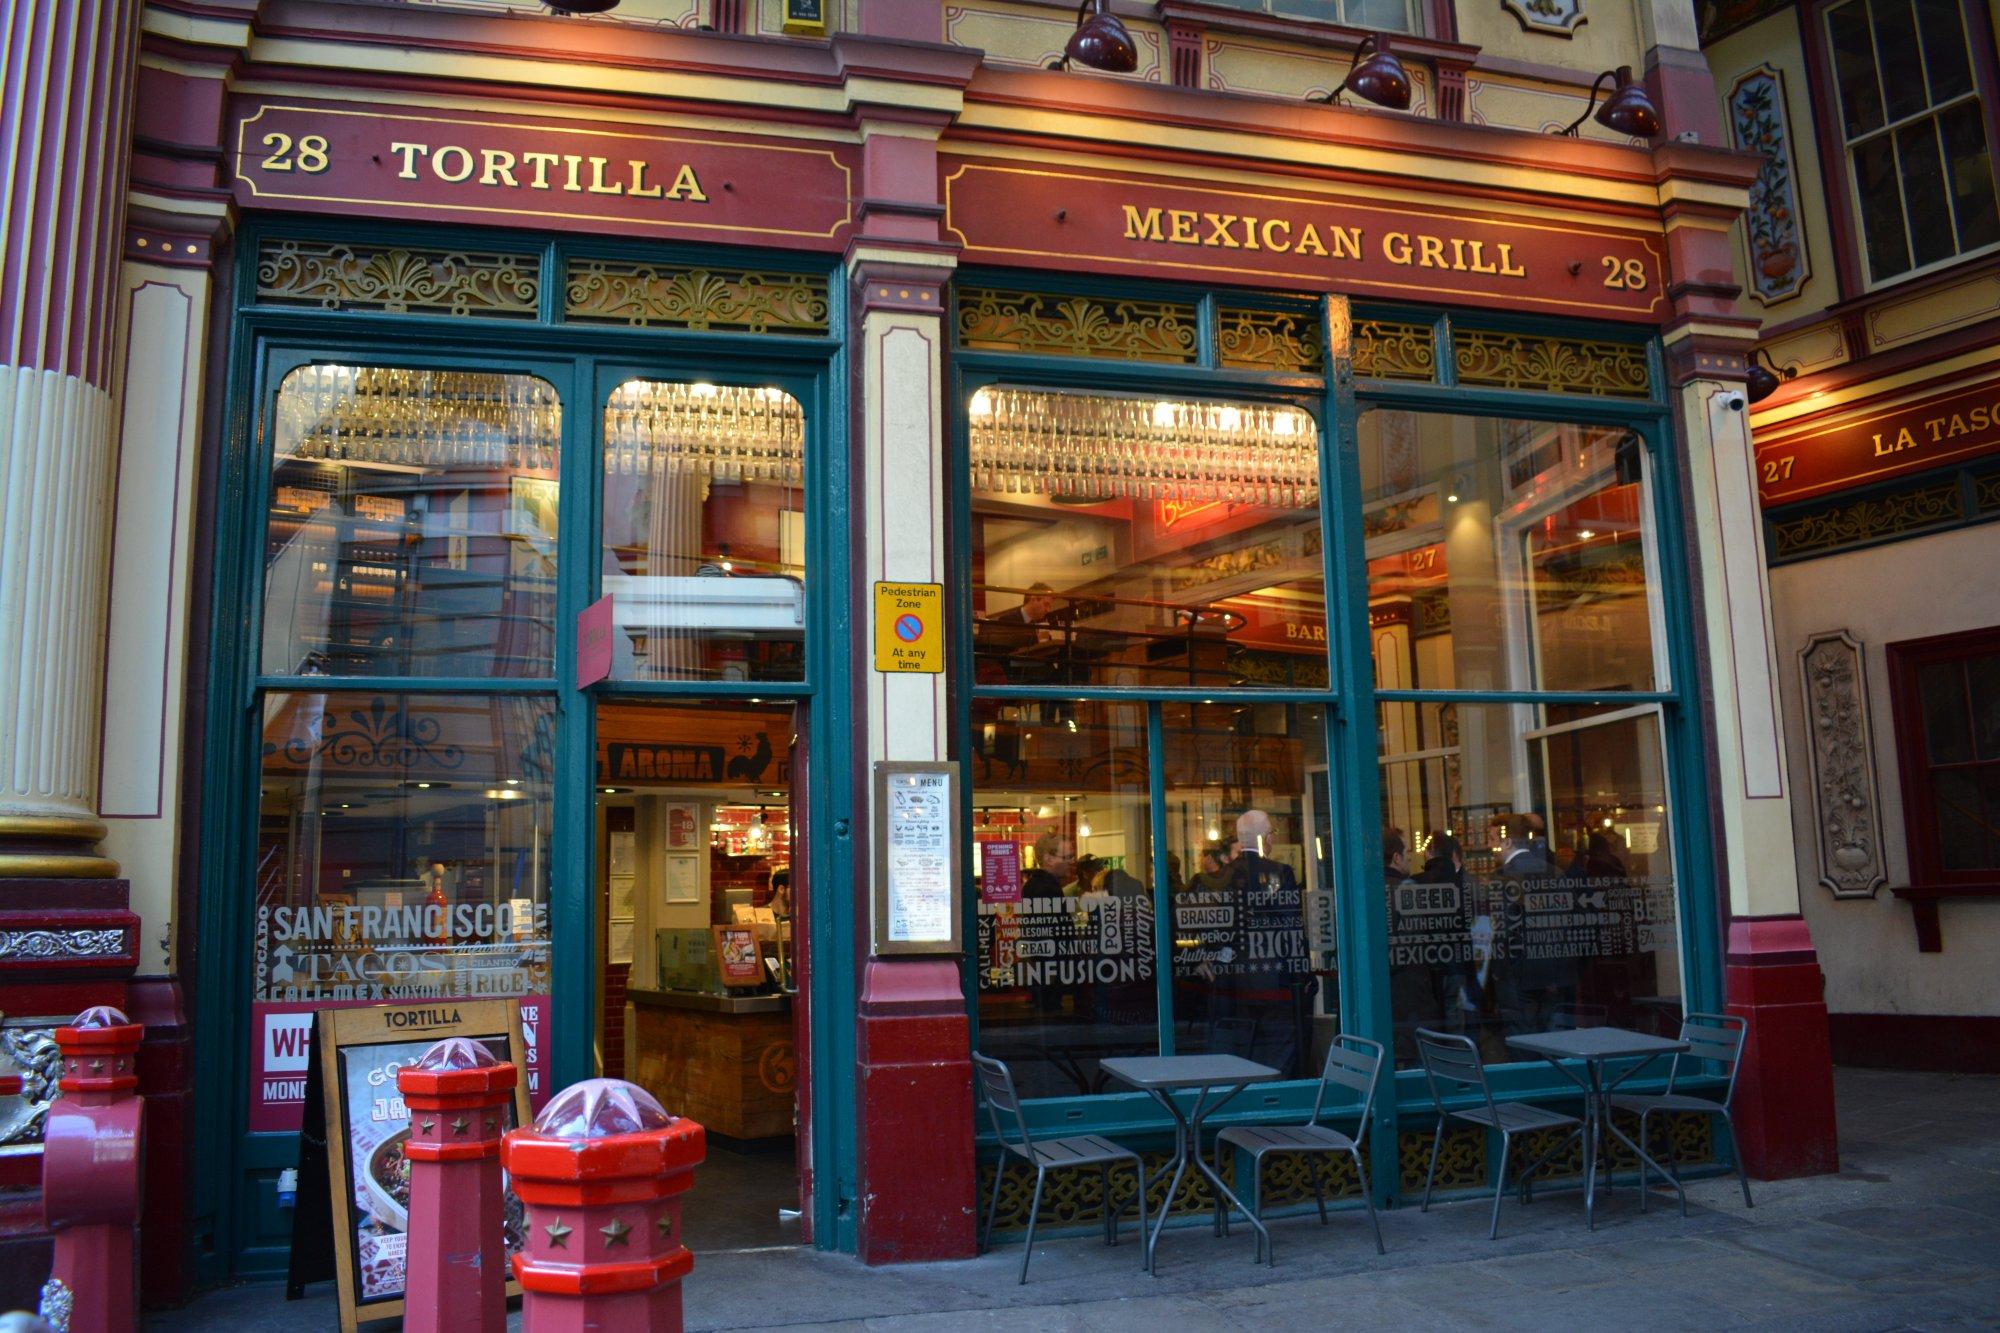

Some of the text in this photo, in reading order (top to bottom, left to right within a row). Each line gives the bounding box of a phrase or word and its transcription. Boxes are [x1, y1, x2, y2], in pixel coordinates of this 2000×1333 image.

[261, 133, 329, 173] 28
[390, 142, 707, 202] TORTILLA
[1122, 205, 1525, 278] MEXICAN GRILL
[1601, 255, 1647, 291] 28
[1873, 428, 1916, 457] LA
[1763, 456, 1795, 483] 27
[1413, 549, 1437, 571] 27
[881, 586, 936, 598] Pedestrian
[896, 598, 921, 609] Zone
[892, 648, 926, 660] At any
[898, 659, 921, 670] time
[618, 750, 714, 779] AROMA
[920, 779, 943, 787] MENU
[1522, 876, 1611, 890] QUESADILLAS
[1175, 890, 1234, 905] CARNE
[1247, 889, 1300, 907] PEPPERS
[1400, 888, 1456, 910] BEER
[1462, 880, 1473, 930] CARNITAS
[1529, 895, 1569, 910] SALSA
[273, 905, 333, 941] SAN
[344, 902, 514, 940] FRANCISCO
[1001, 916, 1059, 926] MARGARITA
[1104, 901, 1118, 950] PORK
[1124, 895, 1135, 955] AUTHENTIC
[1181, 908, 1231, 925] BRAISED
[1397, 915, 1462, 931] AUTHENTIC
[1525, 912, 1620, 928] SHREDDED
[1001, 926, 1054, 938] WHOLESOME
[1526, 929, 1565, 943] FROZEN
[1601, 928, 1613, 955] RICE
[256, 905, 269, 1002] AVOCADO
[979, 916, 991, 990] CALI-MEX
[1021, 942, 1051, 955] REAL
[1058, 940, 1099, 955] SAUCE
[1247, 930, 1305, 959] RICE
[1526, 943, 1600, 960] MARGARITA
[297, 951, 450, 982] TACOS
[470, 959, 519, 968] CILANTRO
[1017, 957, 1135, 987] INFUSION
[1287, 957, 1338, 974] TEQUILA
[388, 982, 451, 999] SONORA
[475, 972, 525, 993] RICE
[270, 983, 385, 1002] CALI-MEX
[384, 1008, 462, 1028] TORTILLA
